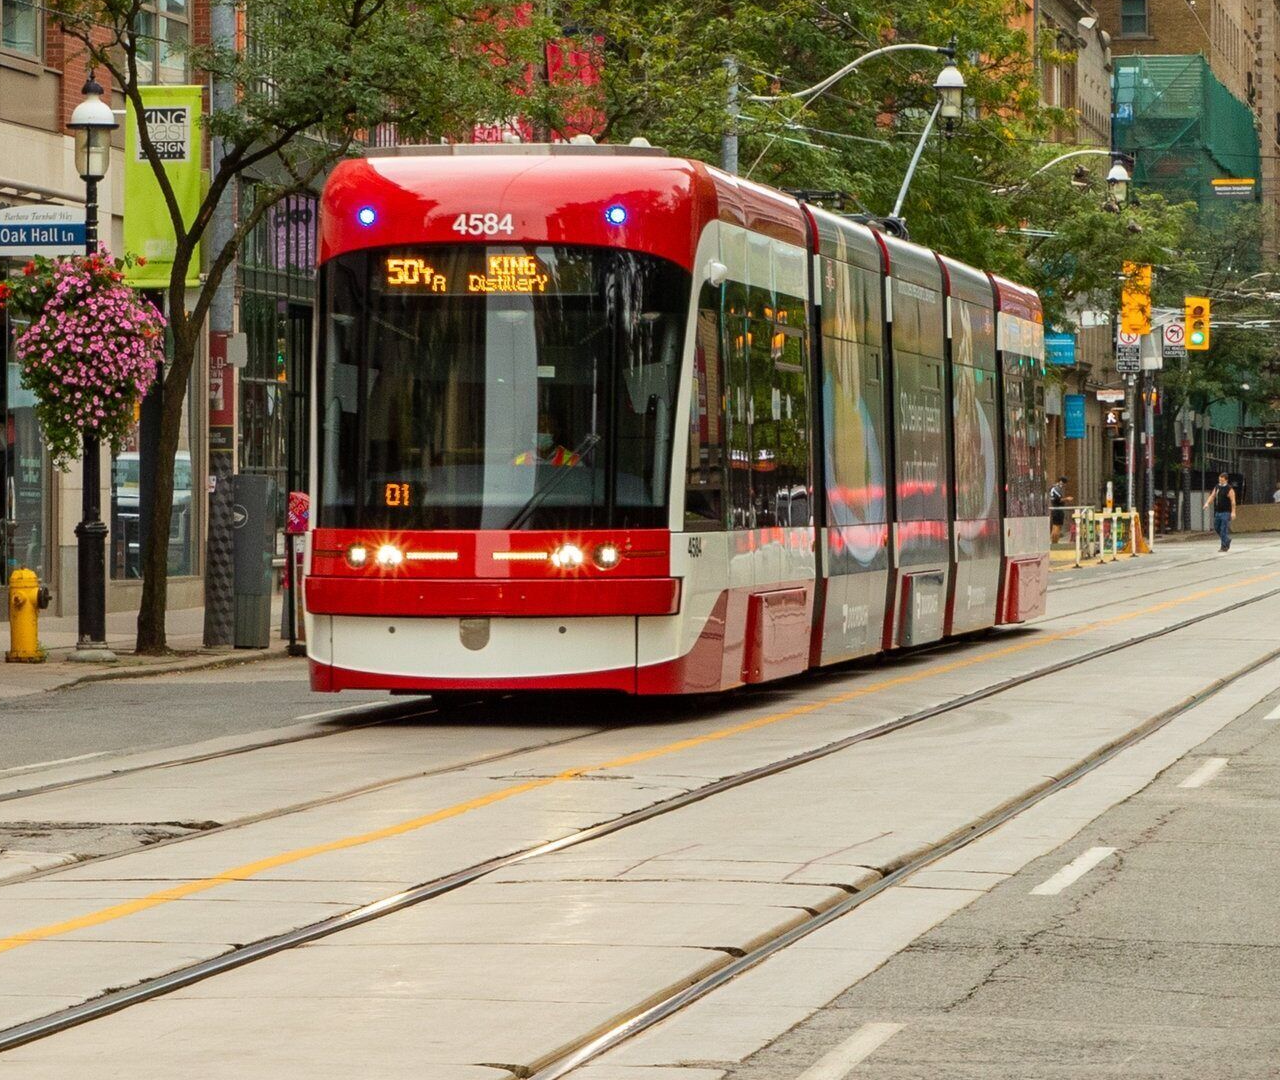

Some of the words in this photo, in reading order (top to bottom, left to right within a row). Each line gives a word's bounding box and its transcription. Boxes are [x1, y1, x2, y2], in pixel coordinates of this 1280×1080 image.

[148, 142, 187, 152] SIGN
[452, 213, 514, 235] 4584
[0, 228, 27, 242] Oak
[31, 228, 58, 242] Hall
[62, 230, 74, 242] Ln
[487, 256, 538, 276] KING
[386, 483, 410, 506] 01
[688, 536, 702, 558] 4584
